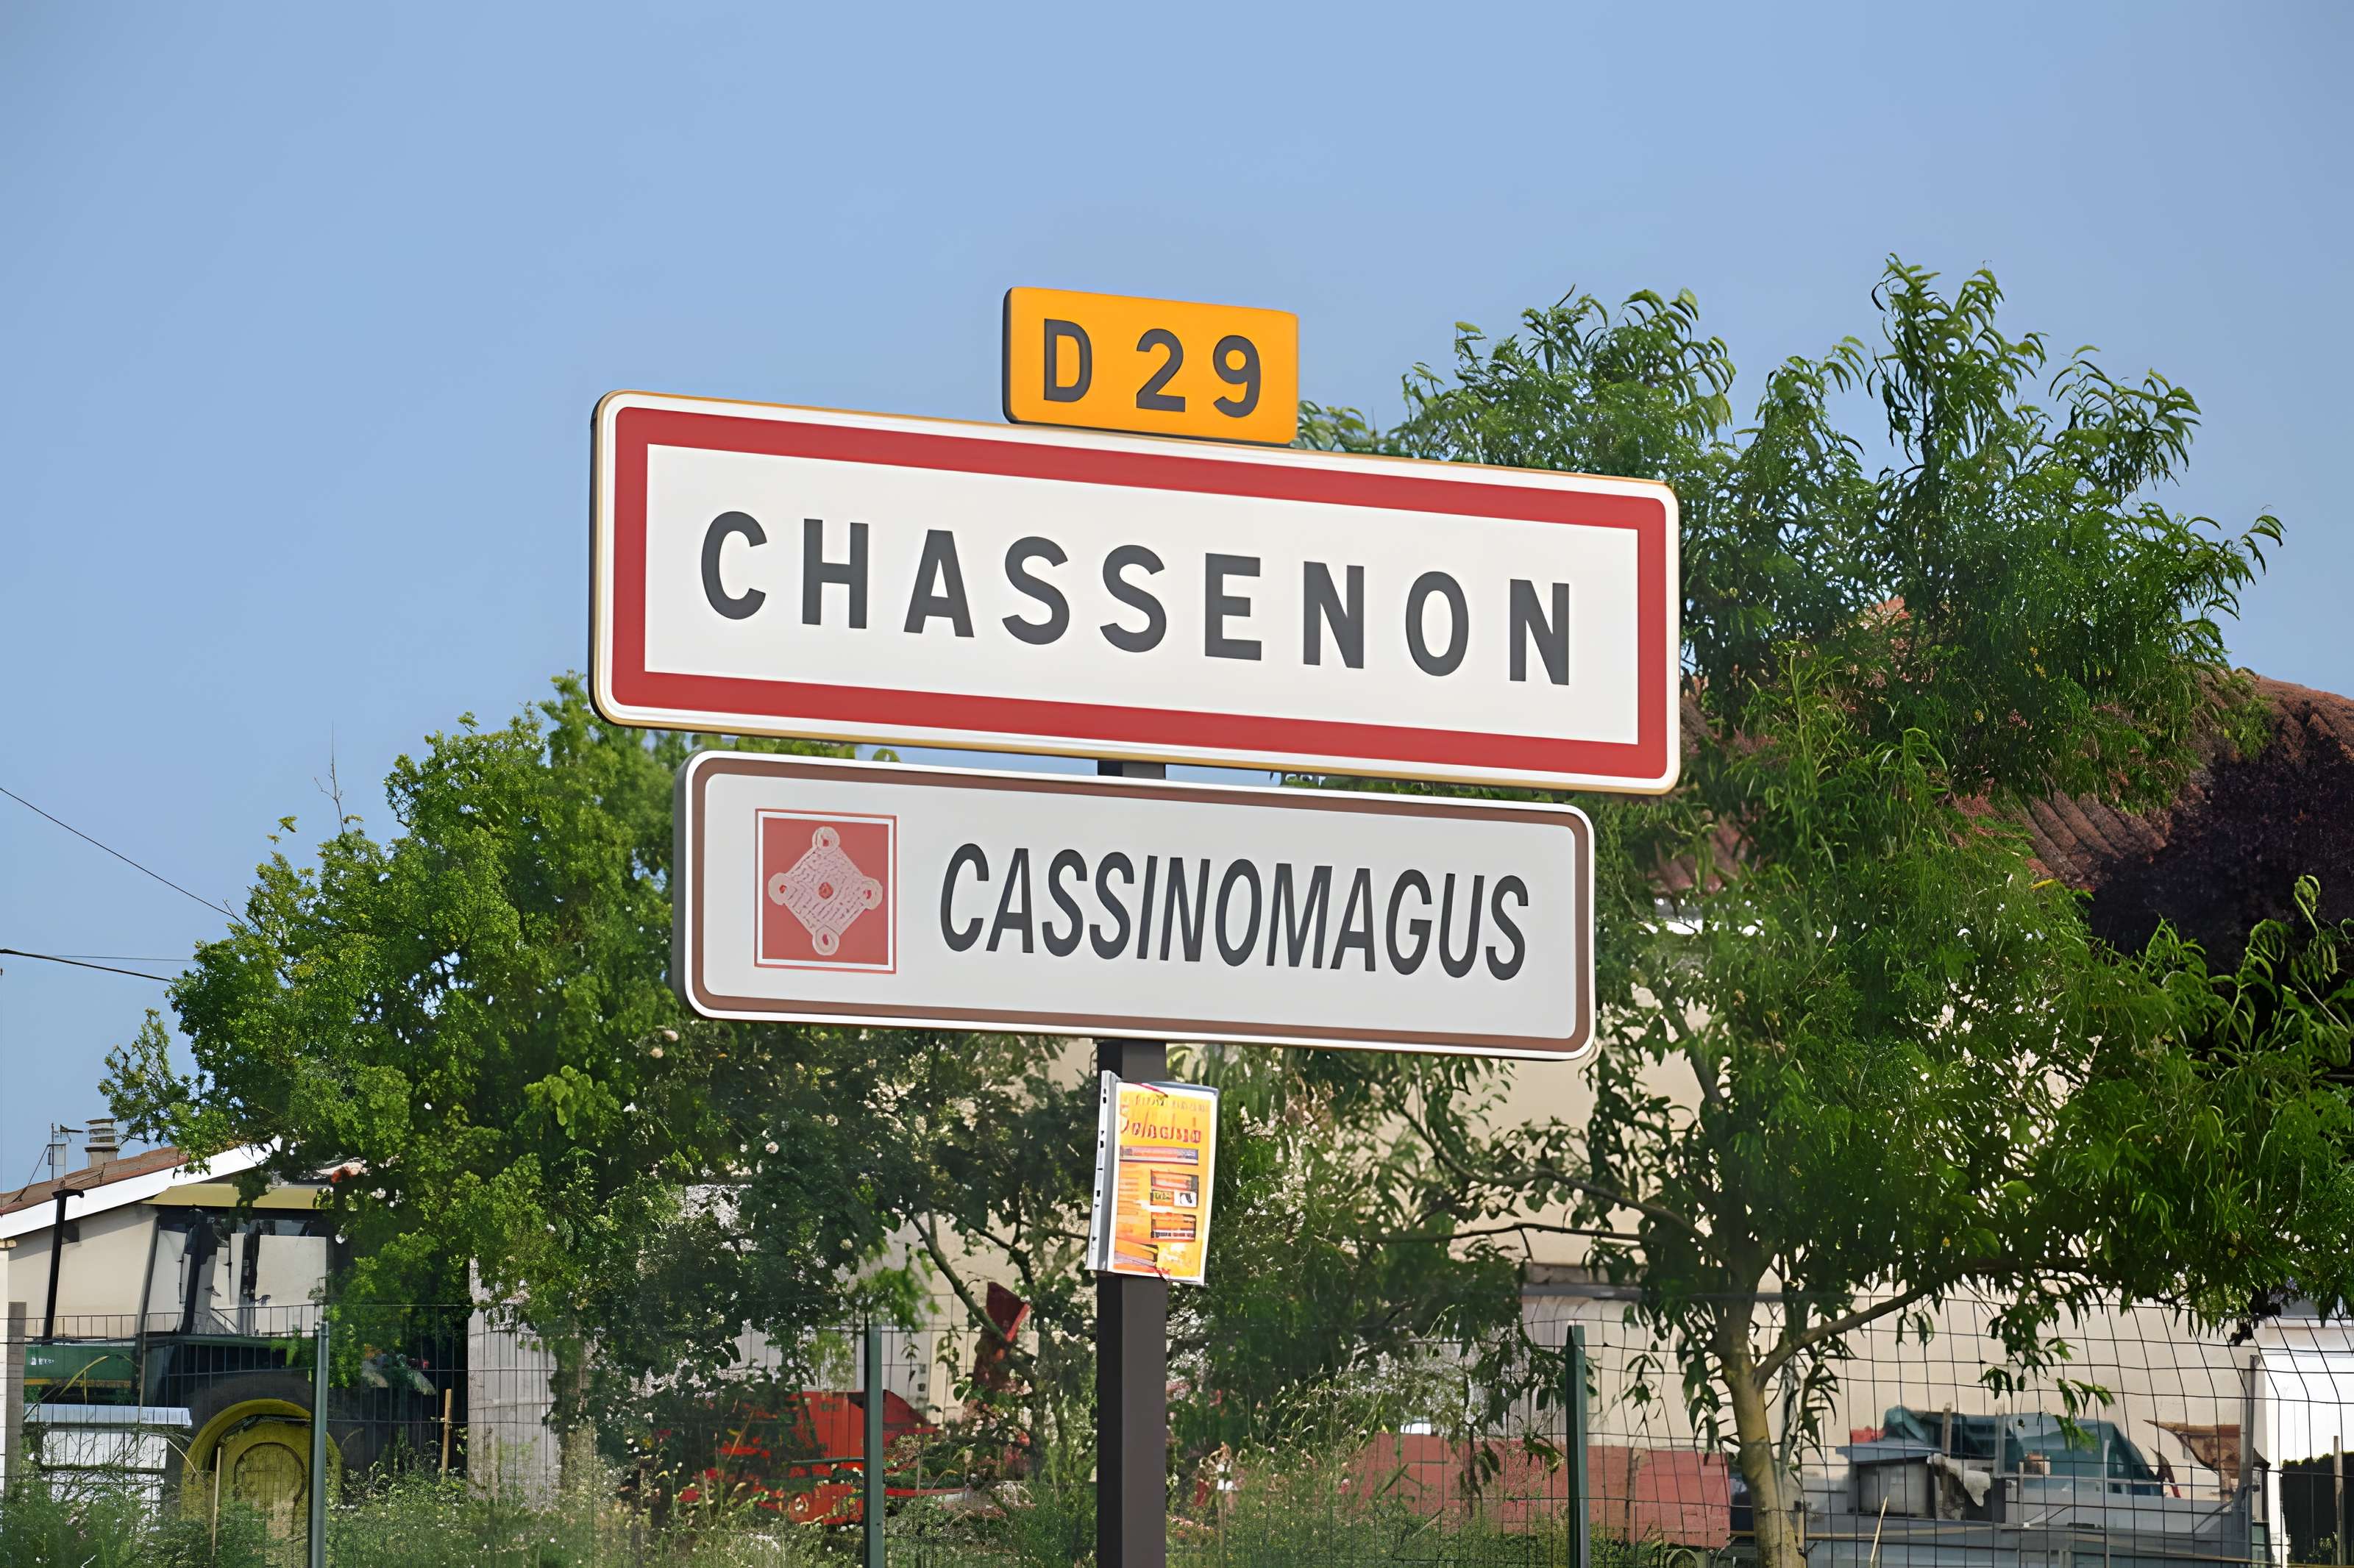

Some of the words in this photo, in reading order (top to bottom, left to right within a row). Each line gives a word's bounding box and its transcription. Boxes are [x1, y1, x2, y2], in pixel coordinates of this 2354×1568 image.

[1043, 318, 1092, 402] D
[1136, 328, 1262, 418] 29
[701, 510, 1570, 686] CHASSENON
[940, 843, 1529, 981] CASSINOMAGUS
